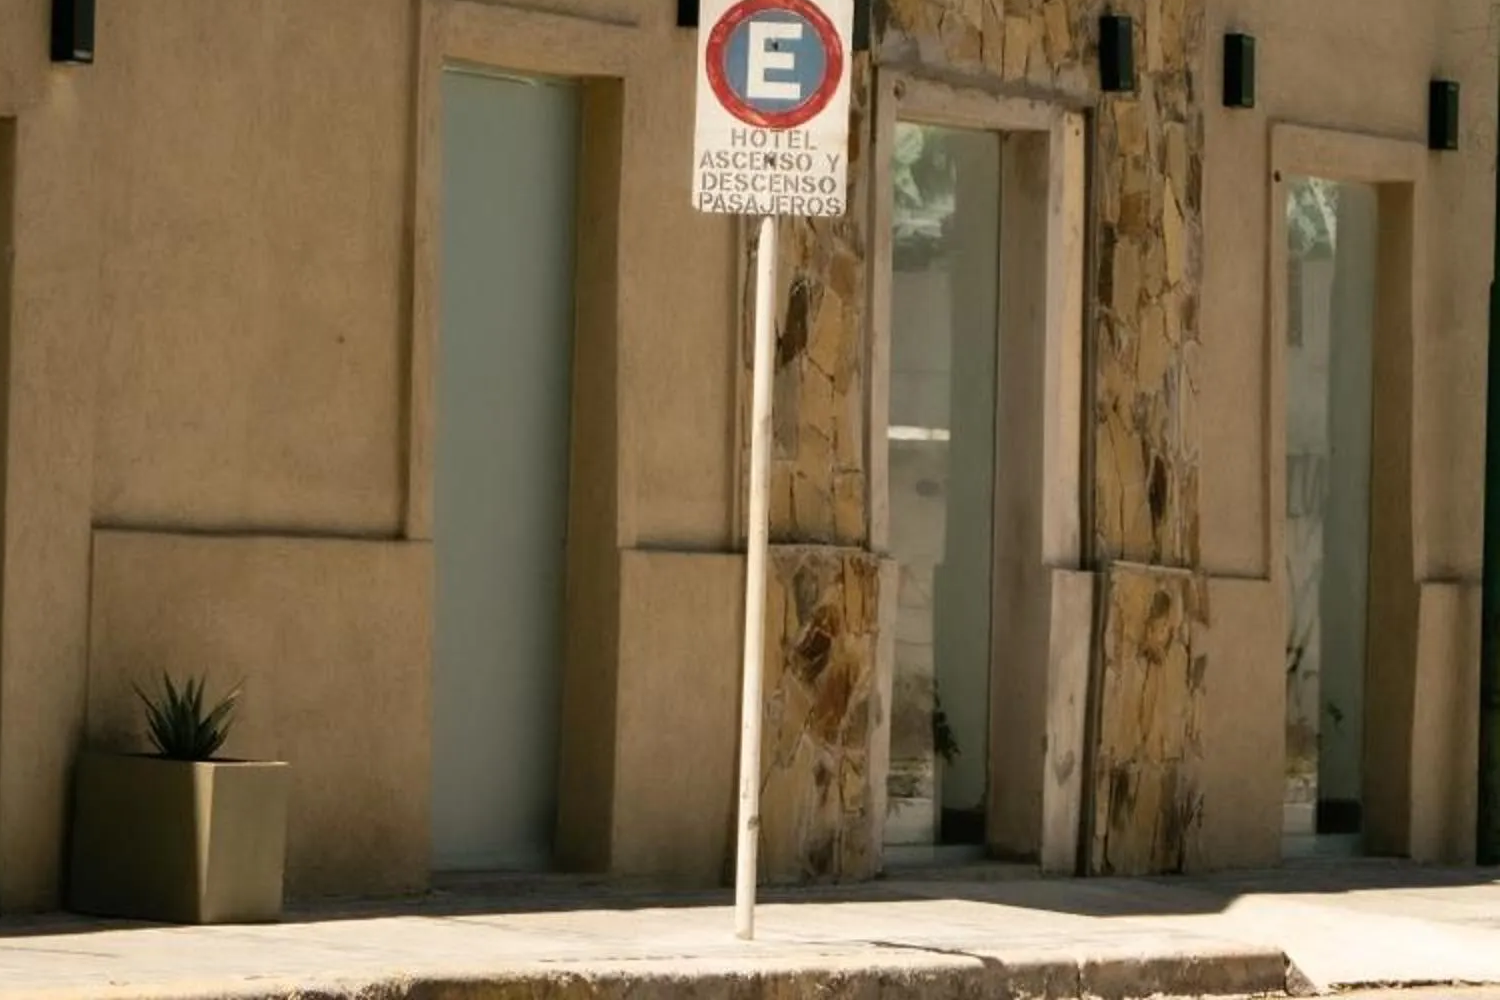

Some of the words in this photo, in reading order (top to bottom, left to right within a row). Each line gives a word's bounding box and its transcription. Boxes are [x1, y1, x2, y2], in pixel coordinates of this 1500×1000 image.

[747, 21, 803, 100] E
[730, 127, 818, 150] HOTEL
[699, 150, 813, 172] ASCENSO
[826, 153, 841, 174] Y
[701, 171, 837, 195] DESCENSO
[699, 192, 842, 216] PASAJEROS
